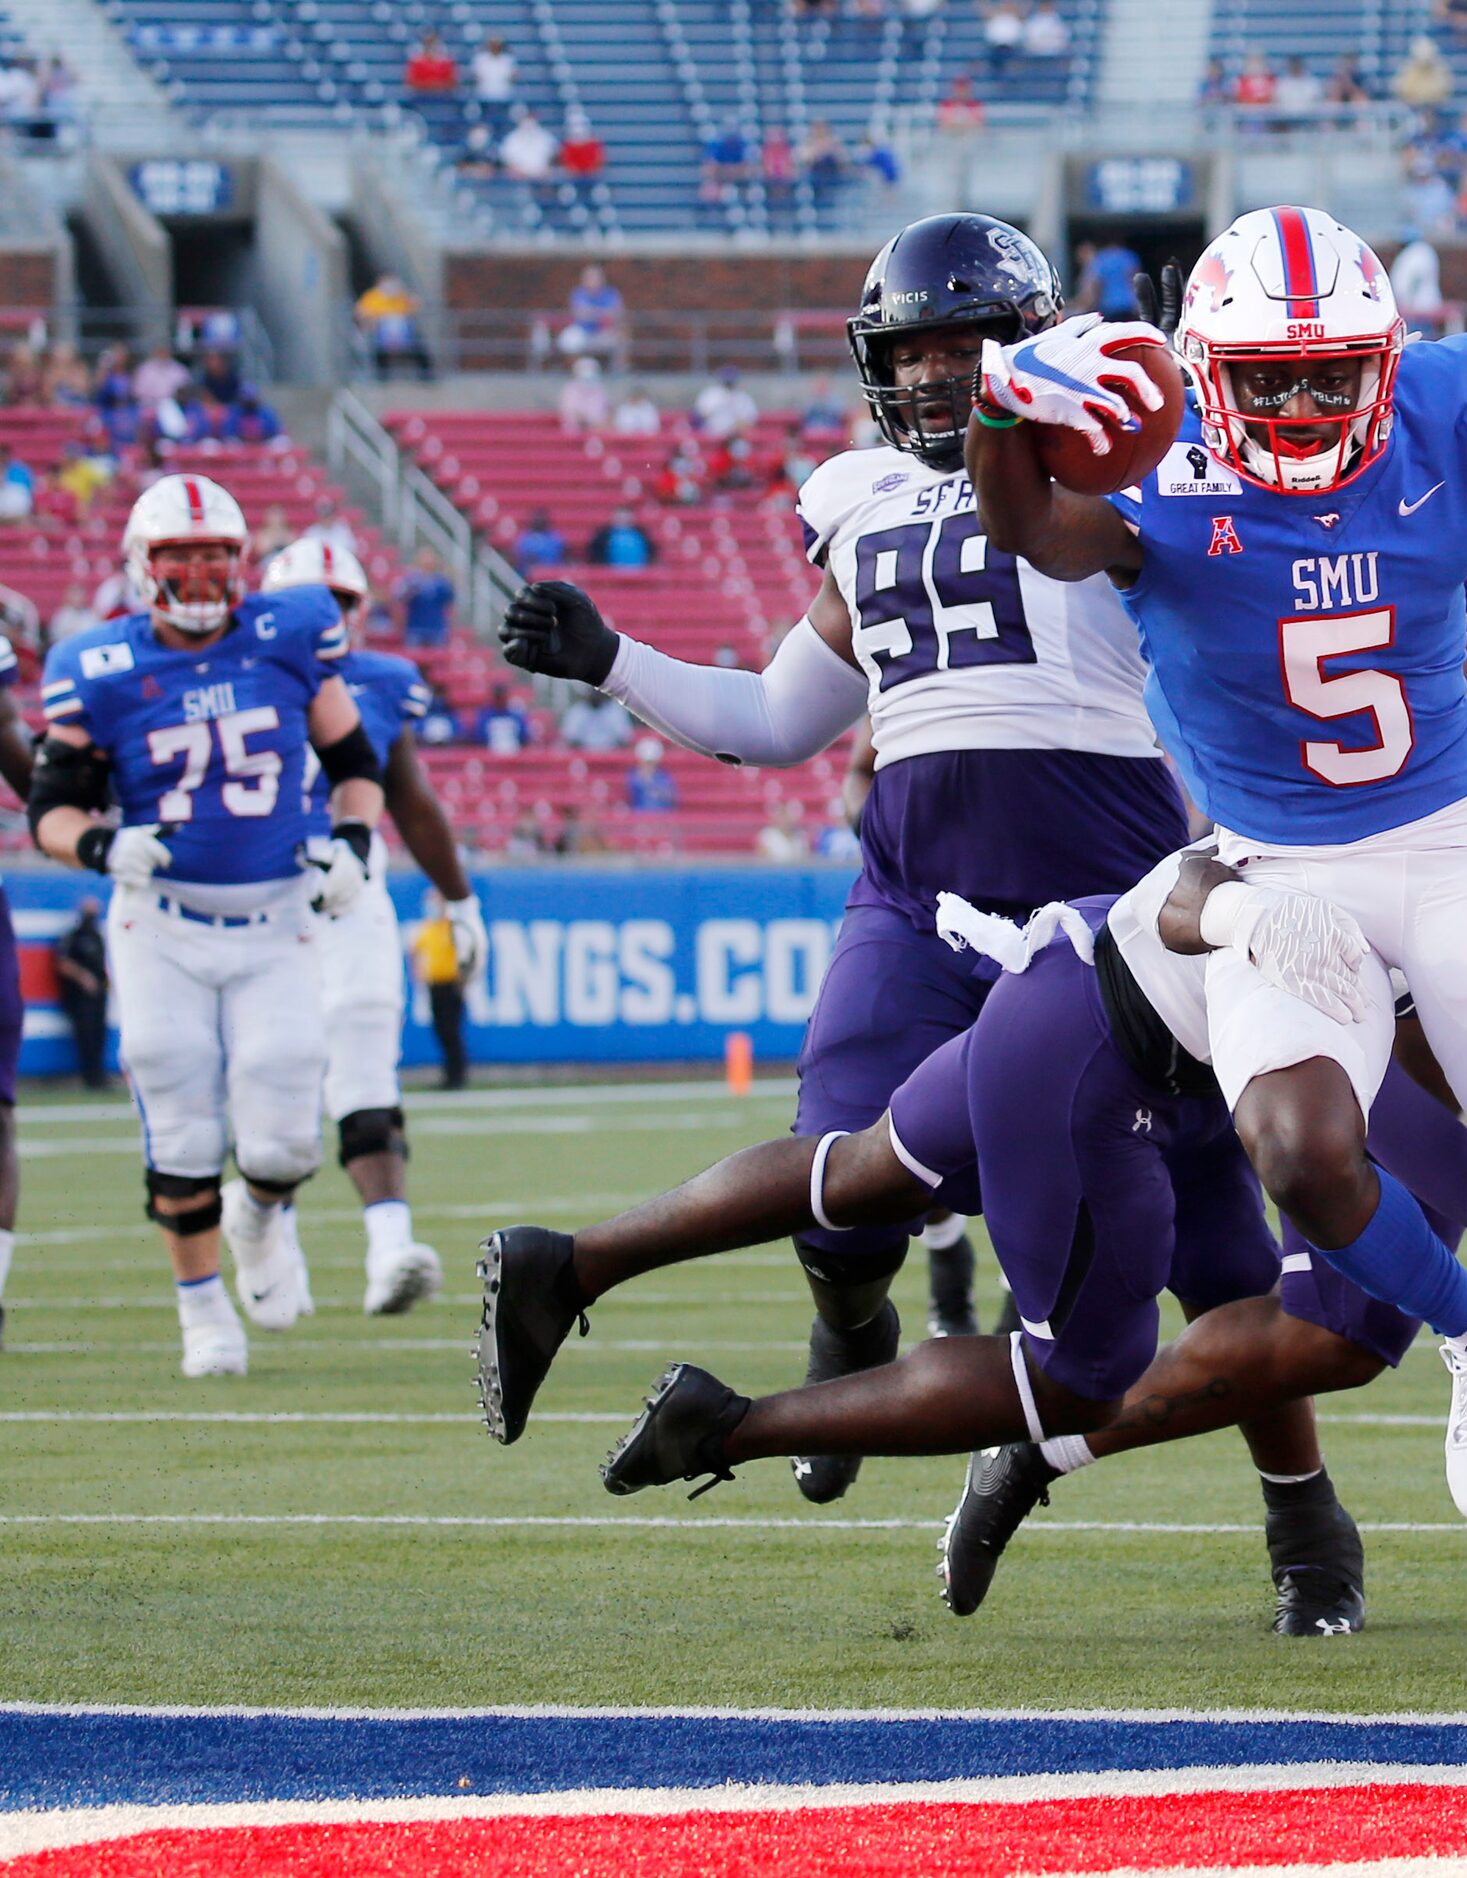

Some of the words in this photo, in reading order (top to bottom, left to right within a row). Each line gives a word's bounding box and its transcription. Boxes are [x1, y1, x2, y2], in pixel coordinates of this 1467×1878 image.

[891, 290, 929, 305] VICIS
[1286, 323, 1325, 339] SMU
[910, 479, 975, 516] SFA
[1170, 482, 1199, 494] GREAT
[1201, 482, 1233, 494] FAMILY
[1291, 475, 1321, 483] Riddell
[1207, 515, 1244, 556] A
[1292, 551, 1379, 611] SMU
[855, 511, 1038, 693] 99
[255, 613, 277, 641] C
[182, 682, 237, 723] SMU
[1276, 604, 1417, 788] 5
[146, 705, 283, 823] 75
